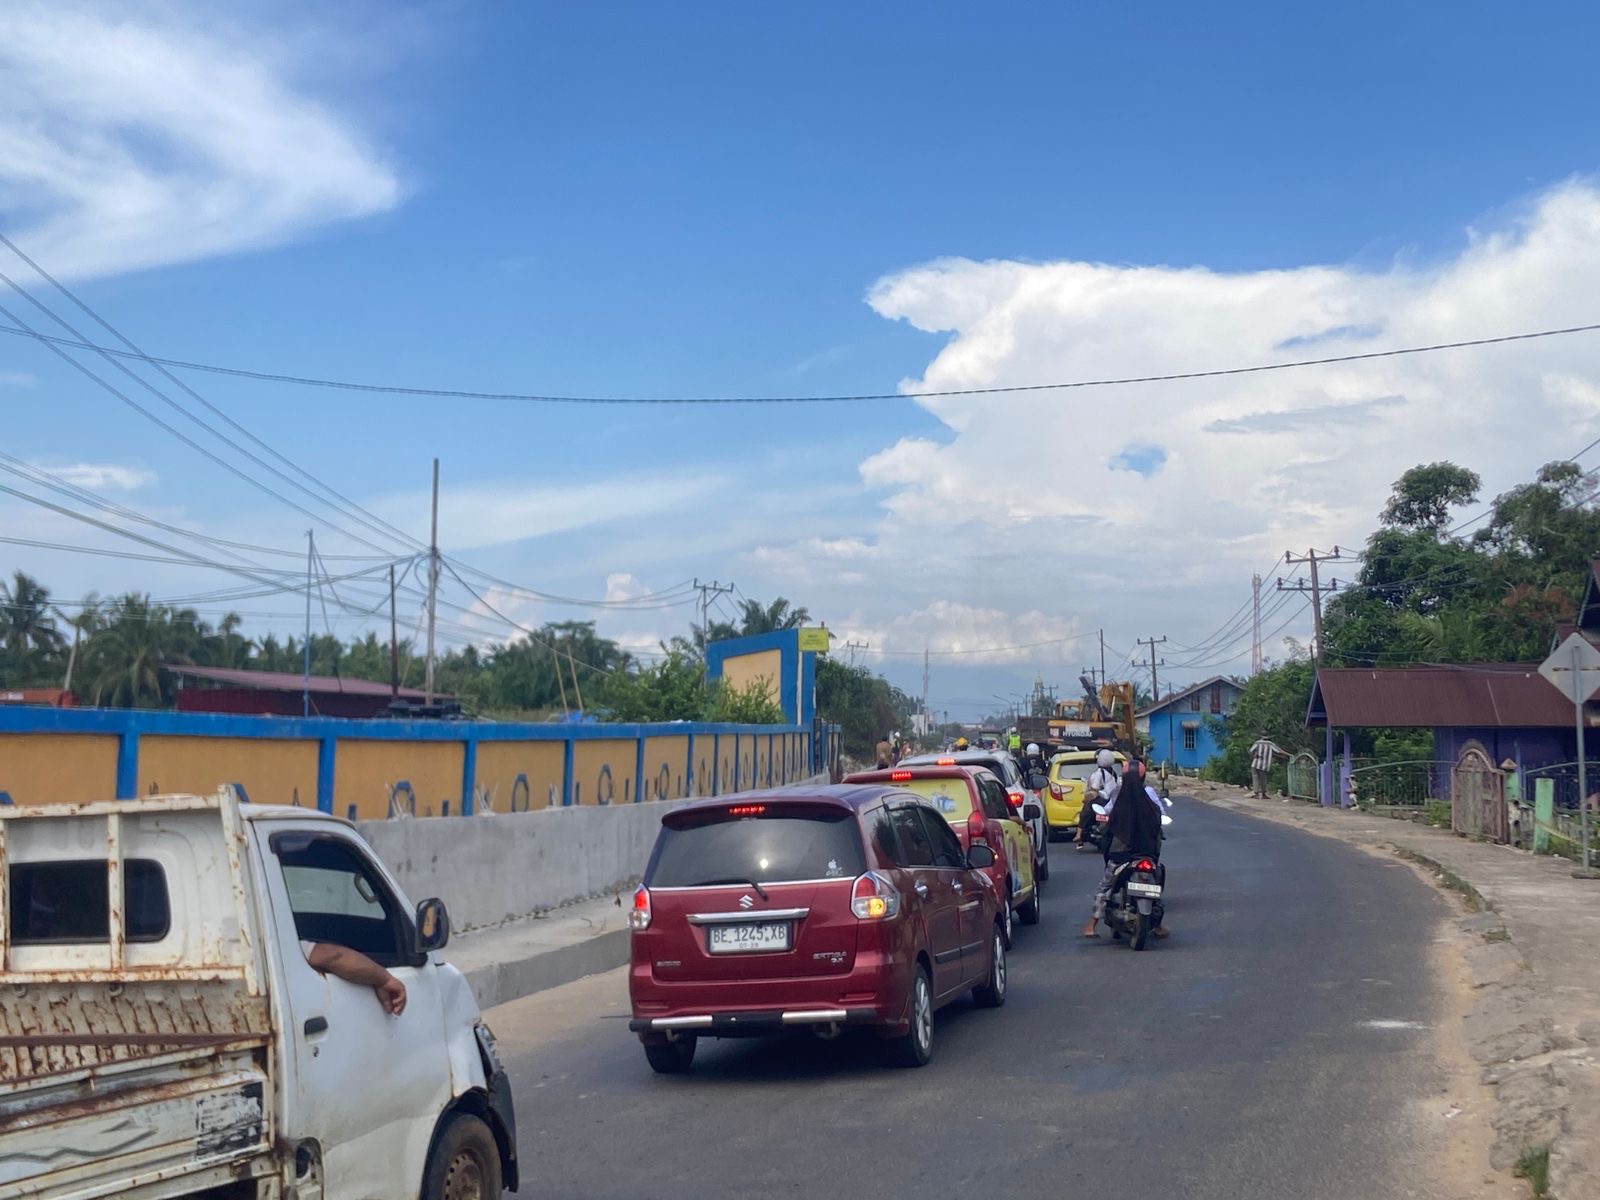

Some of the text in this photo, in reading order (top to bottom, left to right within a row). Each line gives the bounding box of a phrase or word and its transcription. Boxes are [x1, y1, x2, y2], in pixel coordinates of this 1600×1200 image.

[713, 924, 786, 943] BE 1245 XB
